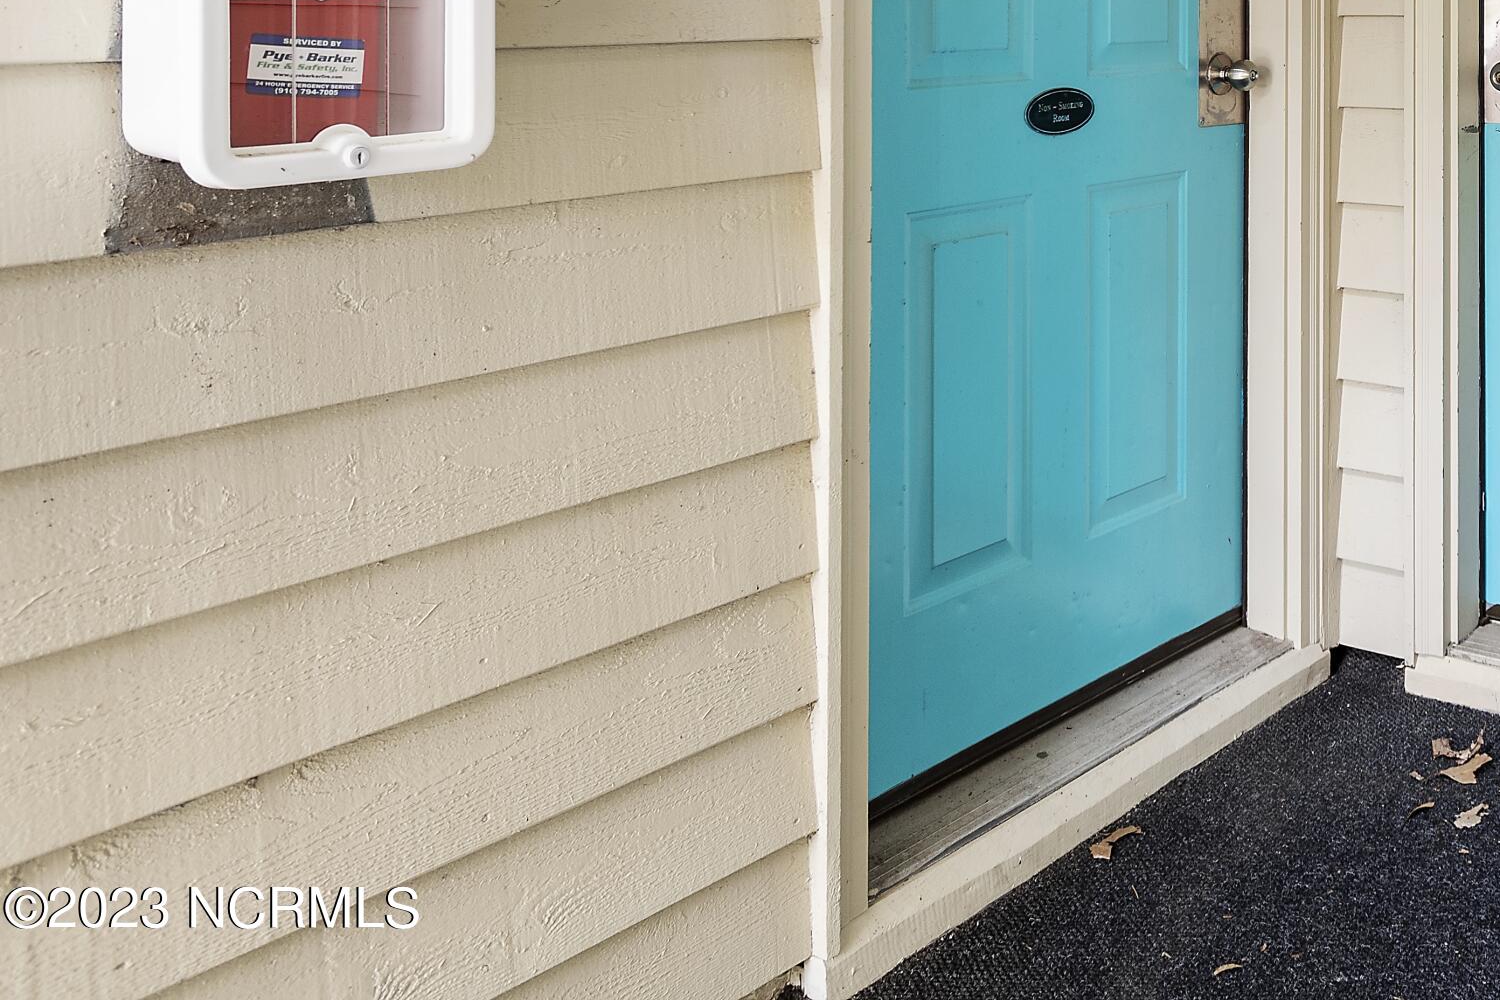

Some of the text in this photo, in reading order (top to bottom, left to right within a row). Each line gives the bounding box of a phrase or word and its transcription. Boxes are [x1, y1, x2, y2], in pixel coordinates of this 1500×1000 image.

[330, 40, 342, 48] BY
[262, 50, 357, 64] Pye Barker
[256, 61, 280, 69] Fire
[287, 82, 329, 90] EERGENCY
[300, 88, 339, 96] 794-7005
